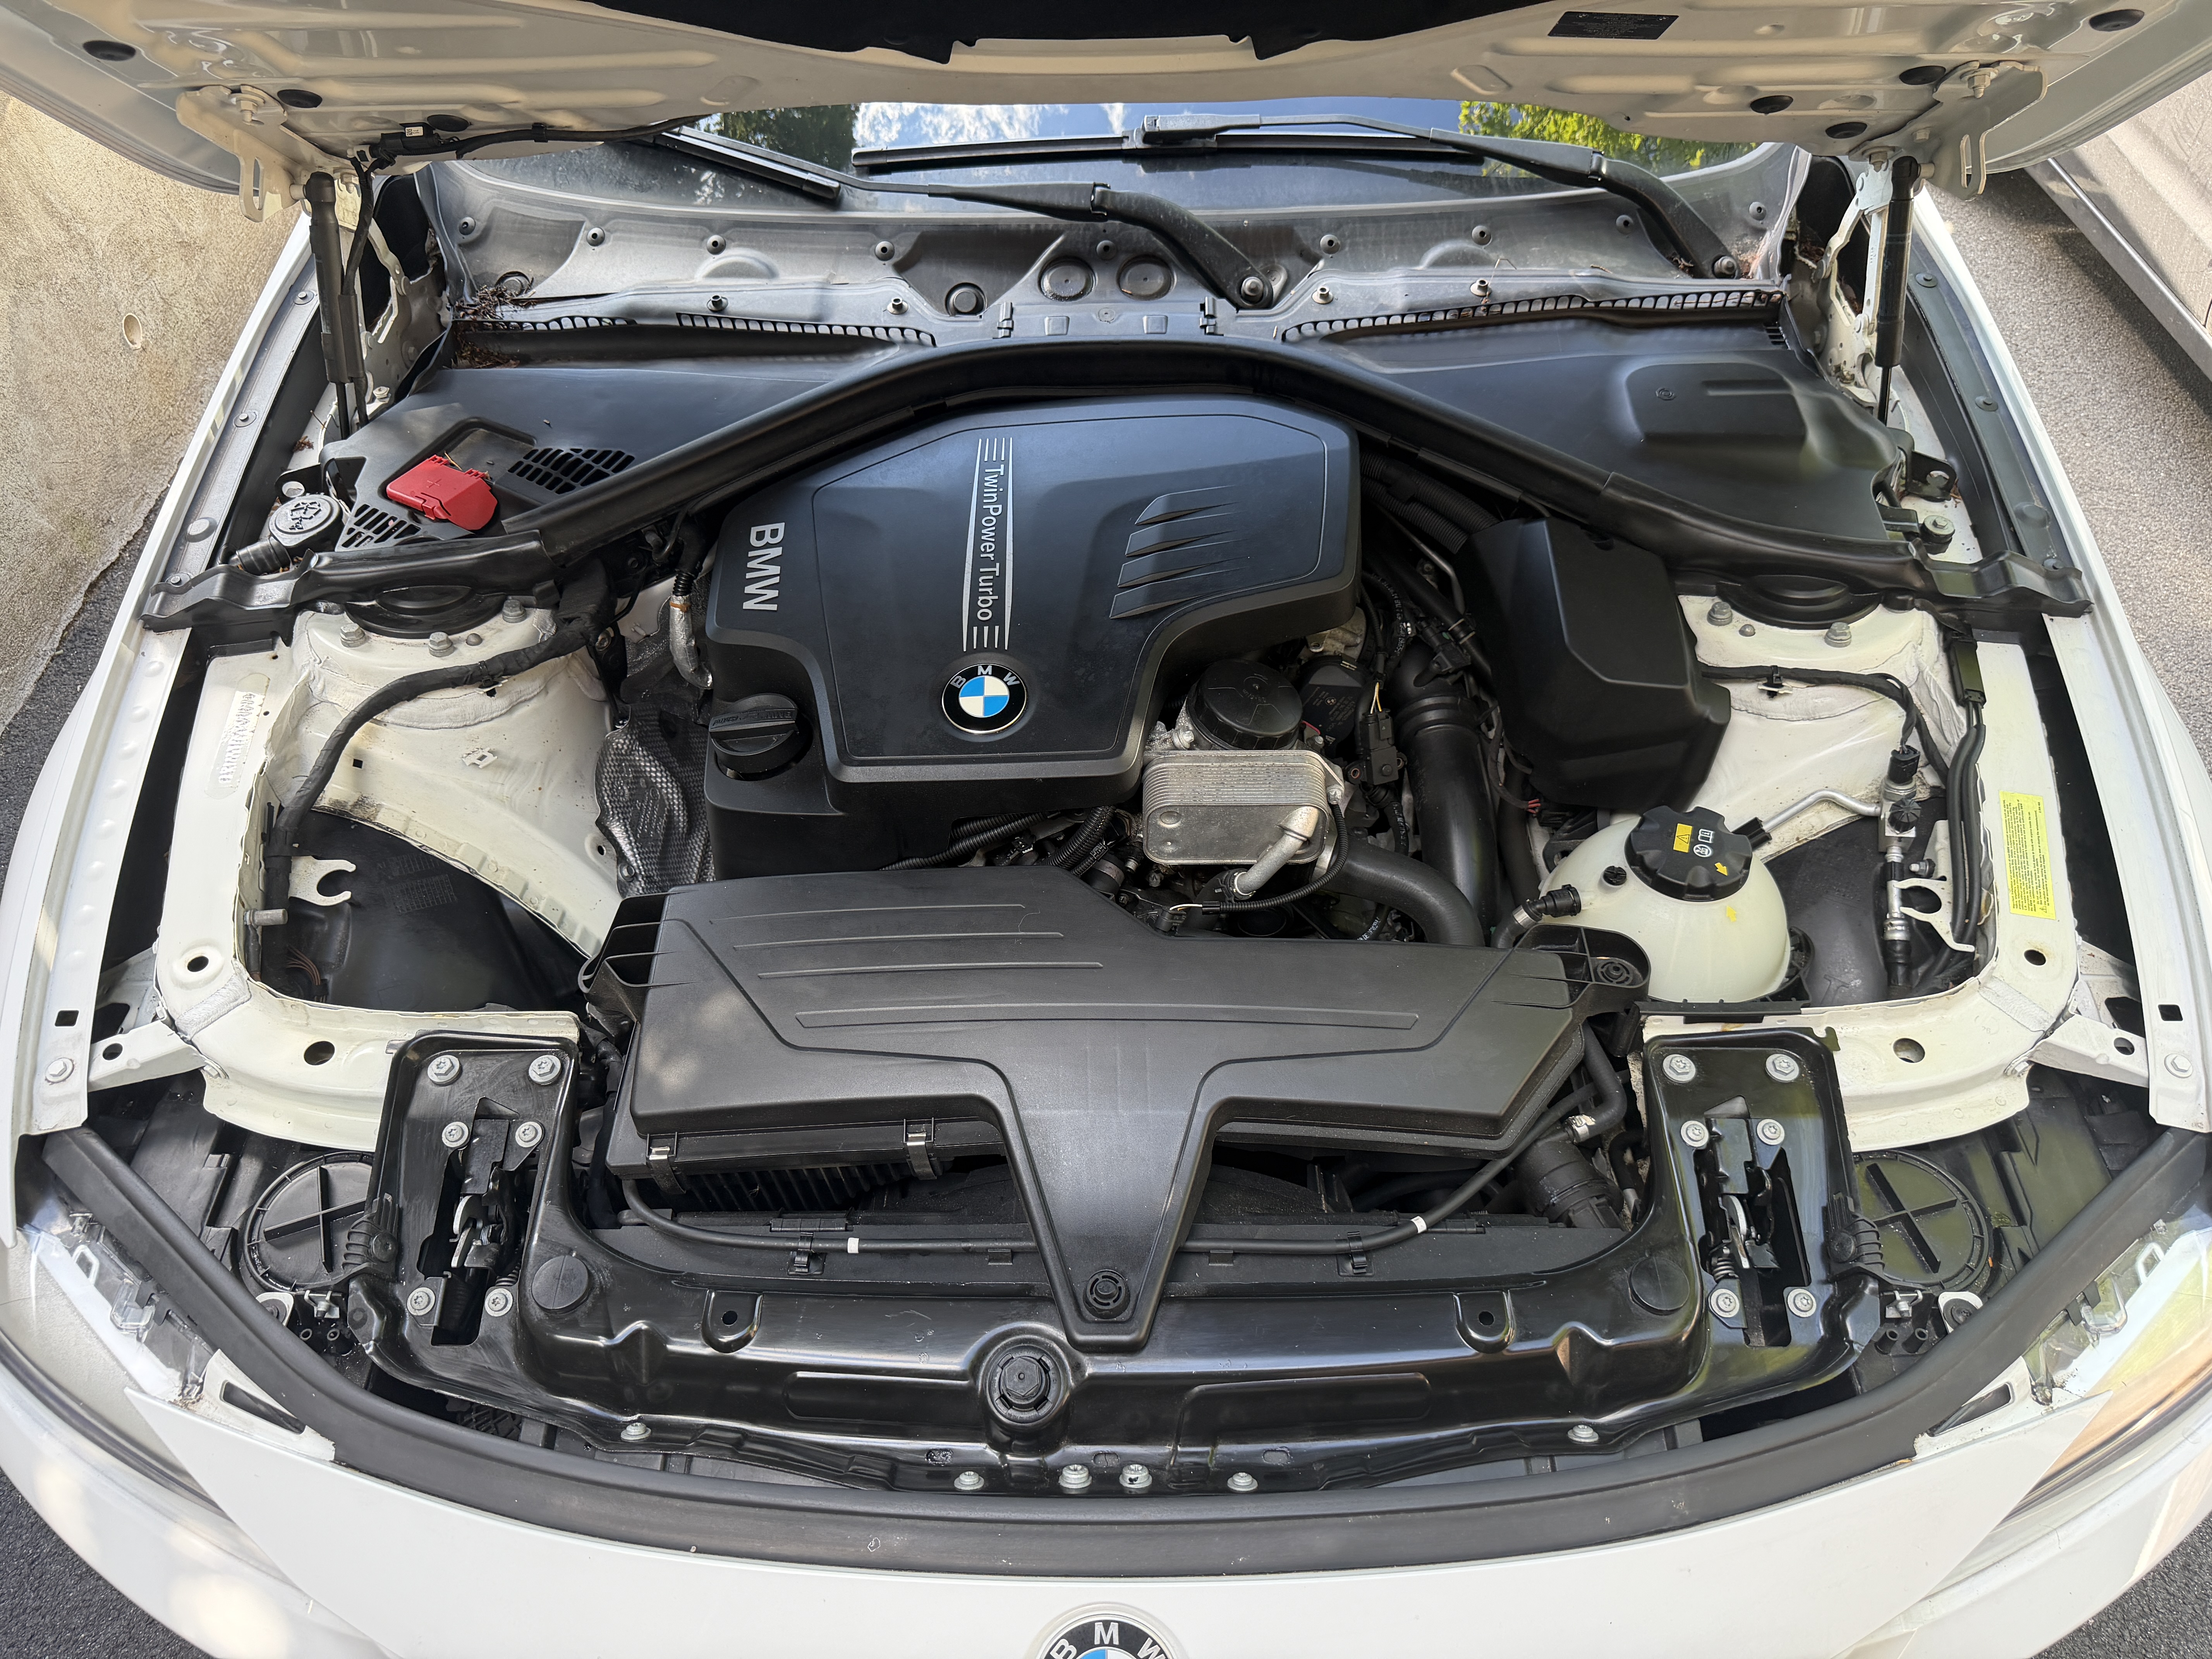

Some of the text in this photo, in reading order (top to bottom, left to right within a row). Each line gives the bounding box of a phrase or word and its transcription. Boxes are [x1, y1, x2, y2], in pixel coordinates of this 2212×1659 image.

[743, 522, 785, 610] BMW
[977, 464, 1004, 621] TwinPower Turbo
[950, 665, 1020, 689] BMW
[1050, 1622, 1166, 1659] BMW
